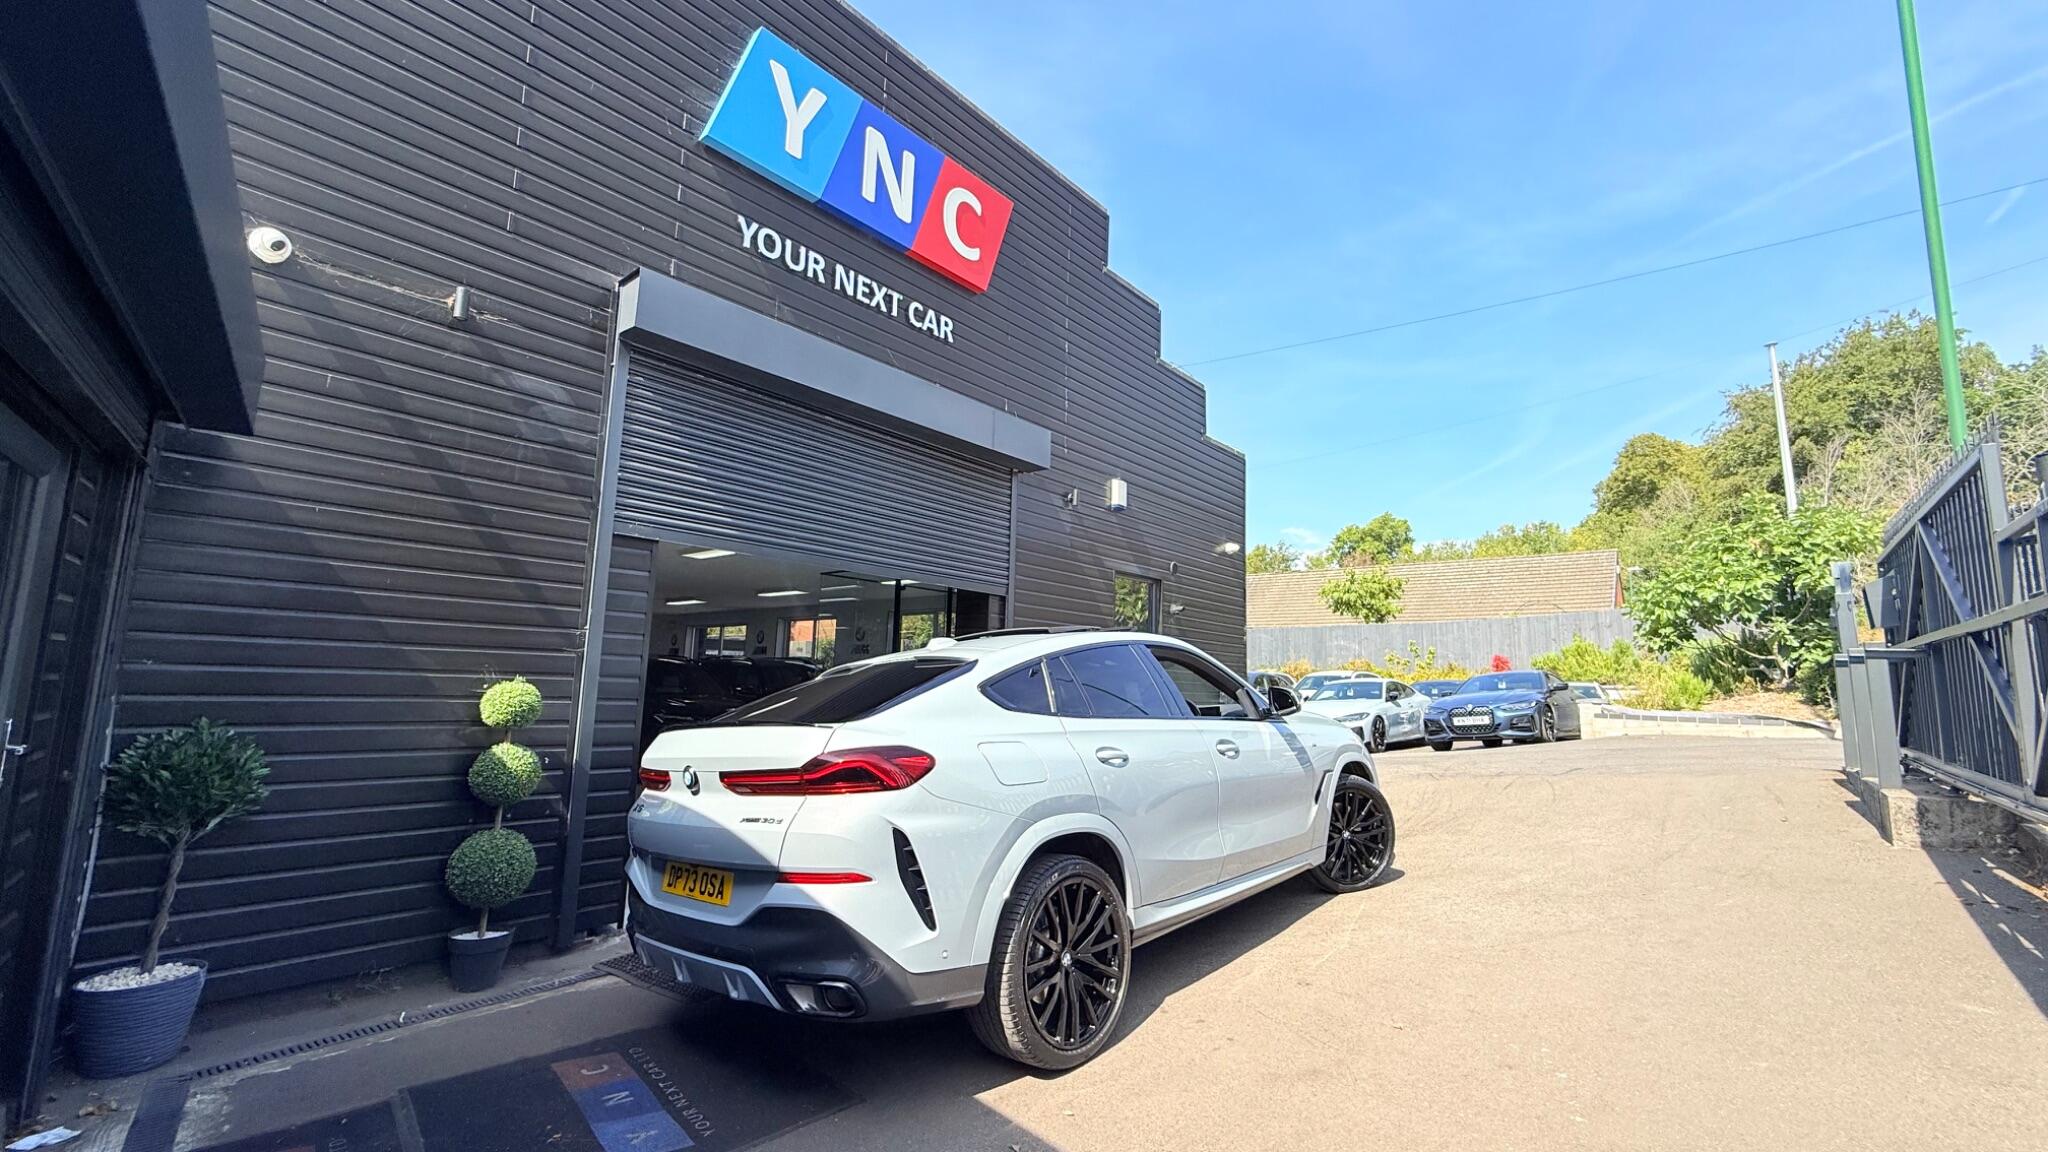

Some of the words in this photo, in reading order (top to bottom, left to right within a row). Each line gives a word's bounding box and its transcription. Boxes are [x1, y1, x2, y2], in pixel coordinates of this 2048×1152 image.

[737, 215, 826, 284] YOUR
[834, 263, 903, 317] NEXT
[908, 301, 954, 343] CAR
[667, 864, 698, 893] DP73
[699, 872, 725, 900] OSA
[658, 1081, 688, 1108] NEXT
[683, 1107, 716, 1138] YOUR
